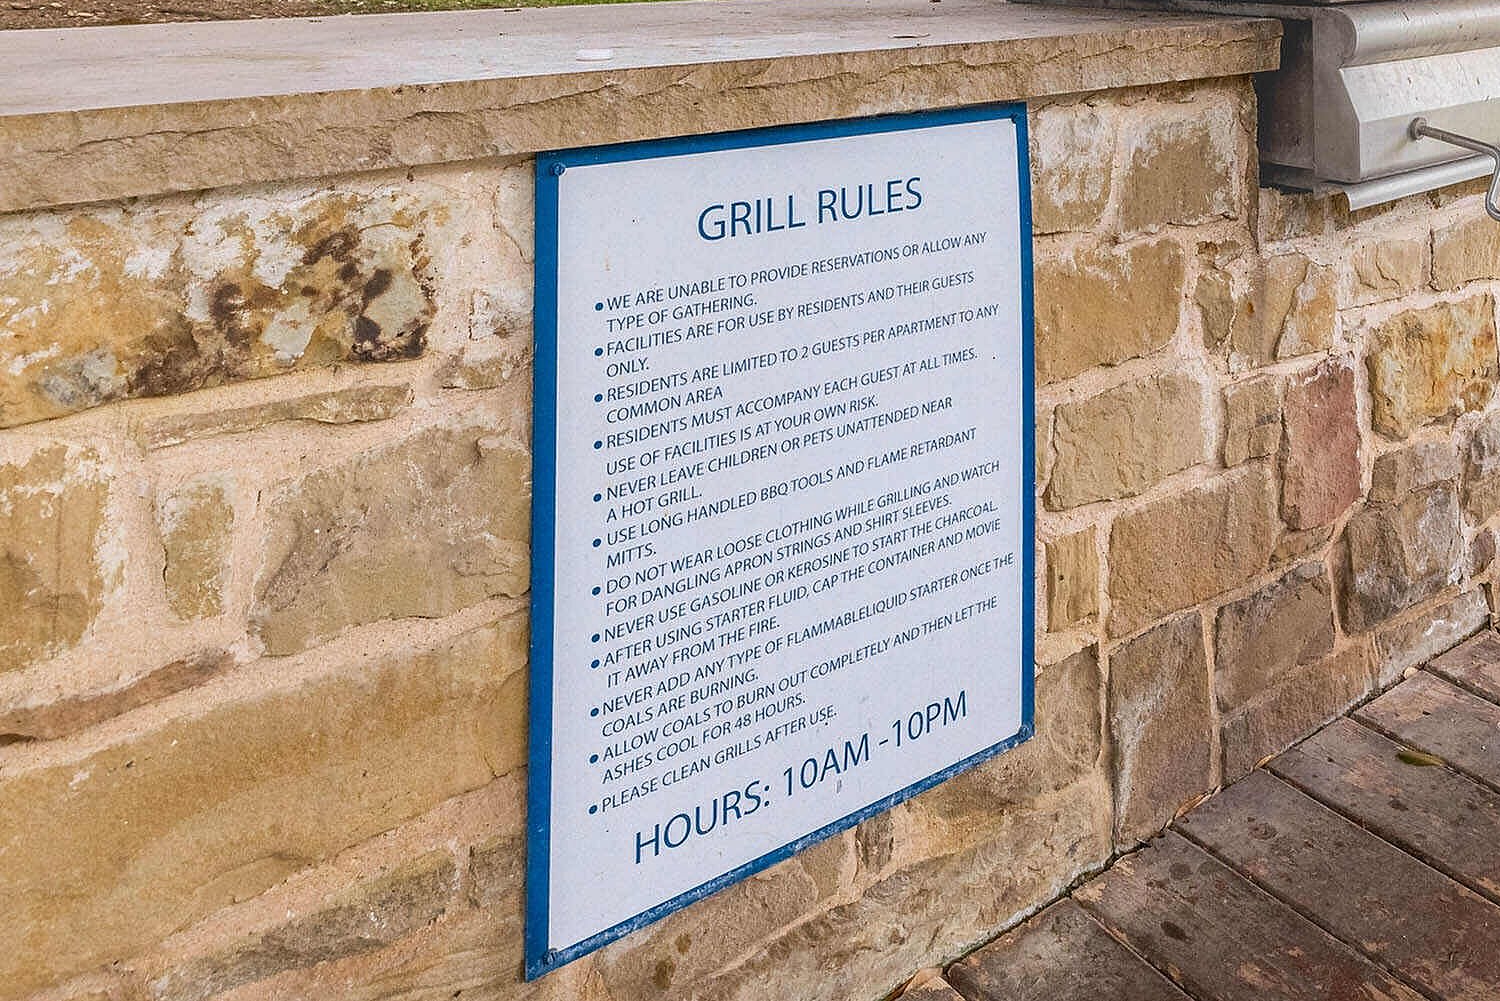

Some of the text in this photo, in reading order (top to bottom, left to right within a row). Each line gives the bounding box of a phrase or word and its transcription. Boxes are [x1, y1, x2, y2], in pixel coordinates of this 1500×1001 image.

[697, 176, 922, 241] GRILL RULES
[606, 231, 988, 311] WE ARE UNABLE TO PROVIDE RESERVATIONS OR ALLOW ANY
[606, 292, 758, 333] TYPE OF GATHERING.
[606, 270, 975, 357] FACILITIES ARE FOR USE BY RESIDENTS AND THEIR GUESTS
[606, 356, 650, 378] ONLY.
[606, 347, 978, 449] RESIDENTS MUST ACCOMPANY EACH GUEST AT ALL TIMES.
[607, 303, 1000, 402] RESIDENTS ARE LIMITED TO 2 GUESTS PER APARTMENT TO ANY
[606, 385, 723, 424] COMMON AREA
[606, 394, 879, 476] USE OF FACILITIES IS AT YOUR OWN RISK.
[606, 396, 953, 501] NEVER LEAVE CHILDREN OR PETS UNATTENDED NEAR
[606, 485, 702, 524] A HOT GRILL.
[606, 459, 1000, 595] DO NOT WEAR LOOSE CLOTHING WHILE GRILLING AND WATCH
[607, 427, 977, 546] USE LONG HANDLED BBQ TOOLS AND FLAME RETARDANT
[603, 518, 1001, 668] AFTER USING STARTER FLUID, CAP THE CONTAINER AND MOVIE
[604, 613, 655, 643] NEVER
[658, 601, 687, 624] USE
[689, 576, 762, 613] GASOLINE
[764, 570, 785, 588] OR
[787, 547, 851, 581] KEROSINE
[851, 542, 870, 558] TO
[872, 528, 909, 552] START
[909, 520, 933, 539] THE
[606, 493, 952, 617] FOR DANGLING APRON STRINGS AND SHIRT SLEEVES.
[606, 542, 657, 569] MITTS.
[602, 685, 653, 716] NEVER
[655, 671, 691, 697] ADD
[694, 657, 726, 683] ANY
[726, 644, 762, 669] TYPE
[764, 636, 784, 655] OF
[909, 572, 959, 602] STARTER
[960, 560, 992, 583] ONCE
[992, 551, 1014, 570] THE
[602, 595, 998, 762] ALLOW COALS TO BURN OUT COMPLETELY AND THEN LET THE
[607, 615, 781, 689] IT AWAY FROM THE FIRE.
[601, 668, 759, 737] COALS ARE BURNING.
[601, 691, 806, 785] ASHES COOL FOR 48 HOURS.
[602, 704, 837, 813] PLEASE CLEAN GRILLS AFTER USE.
[635, 779, 770, 865] HOURS:
[783, 732, 870, 797] 10AM
